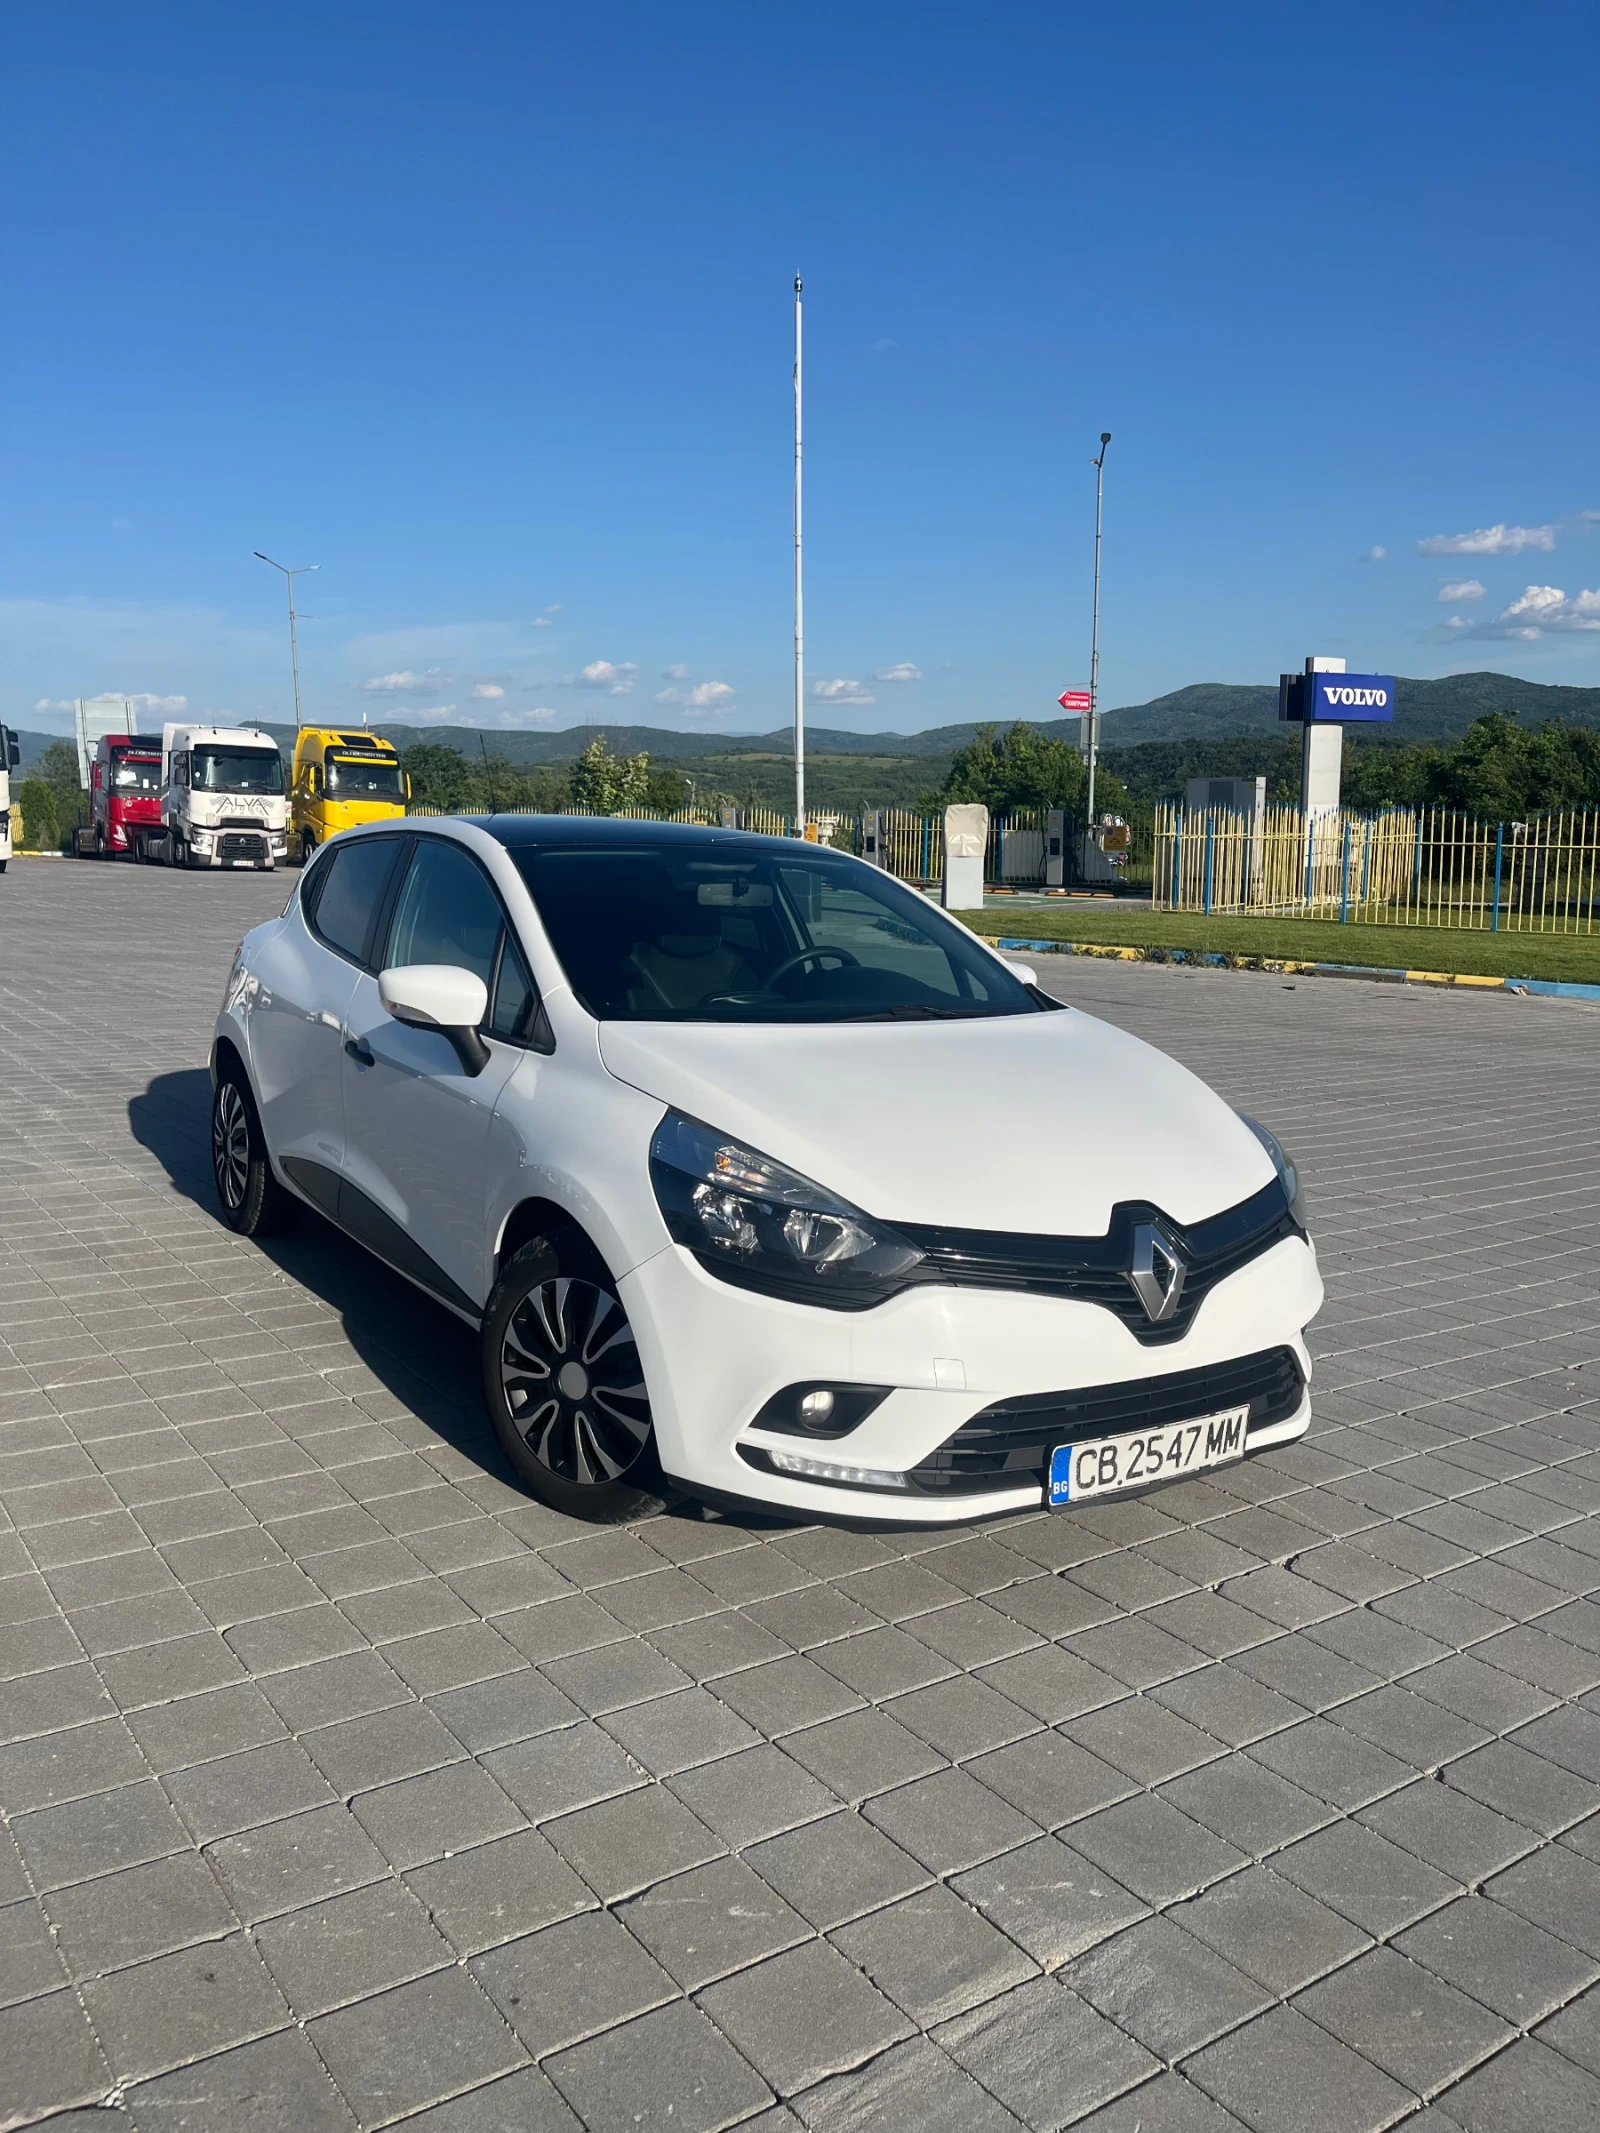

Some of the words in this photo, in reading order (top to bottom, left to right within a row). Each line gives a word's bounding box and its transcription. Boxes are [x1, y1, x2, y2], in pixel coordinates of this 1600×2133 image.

[1323, 687, 1387, 707] VOLVO
[216, 797, 270, 815] ALVA
[1205, 1414, 1243, 1459] MM
[1053, 1481, 1068, 1495] BG
